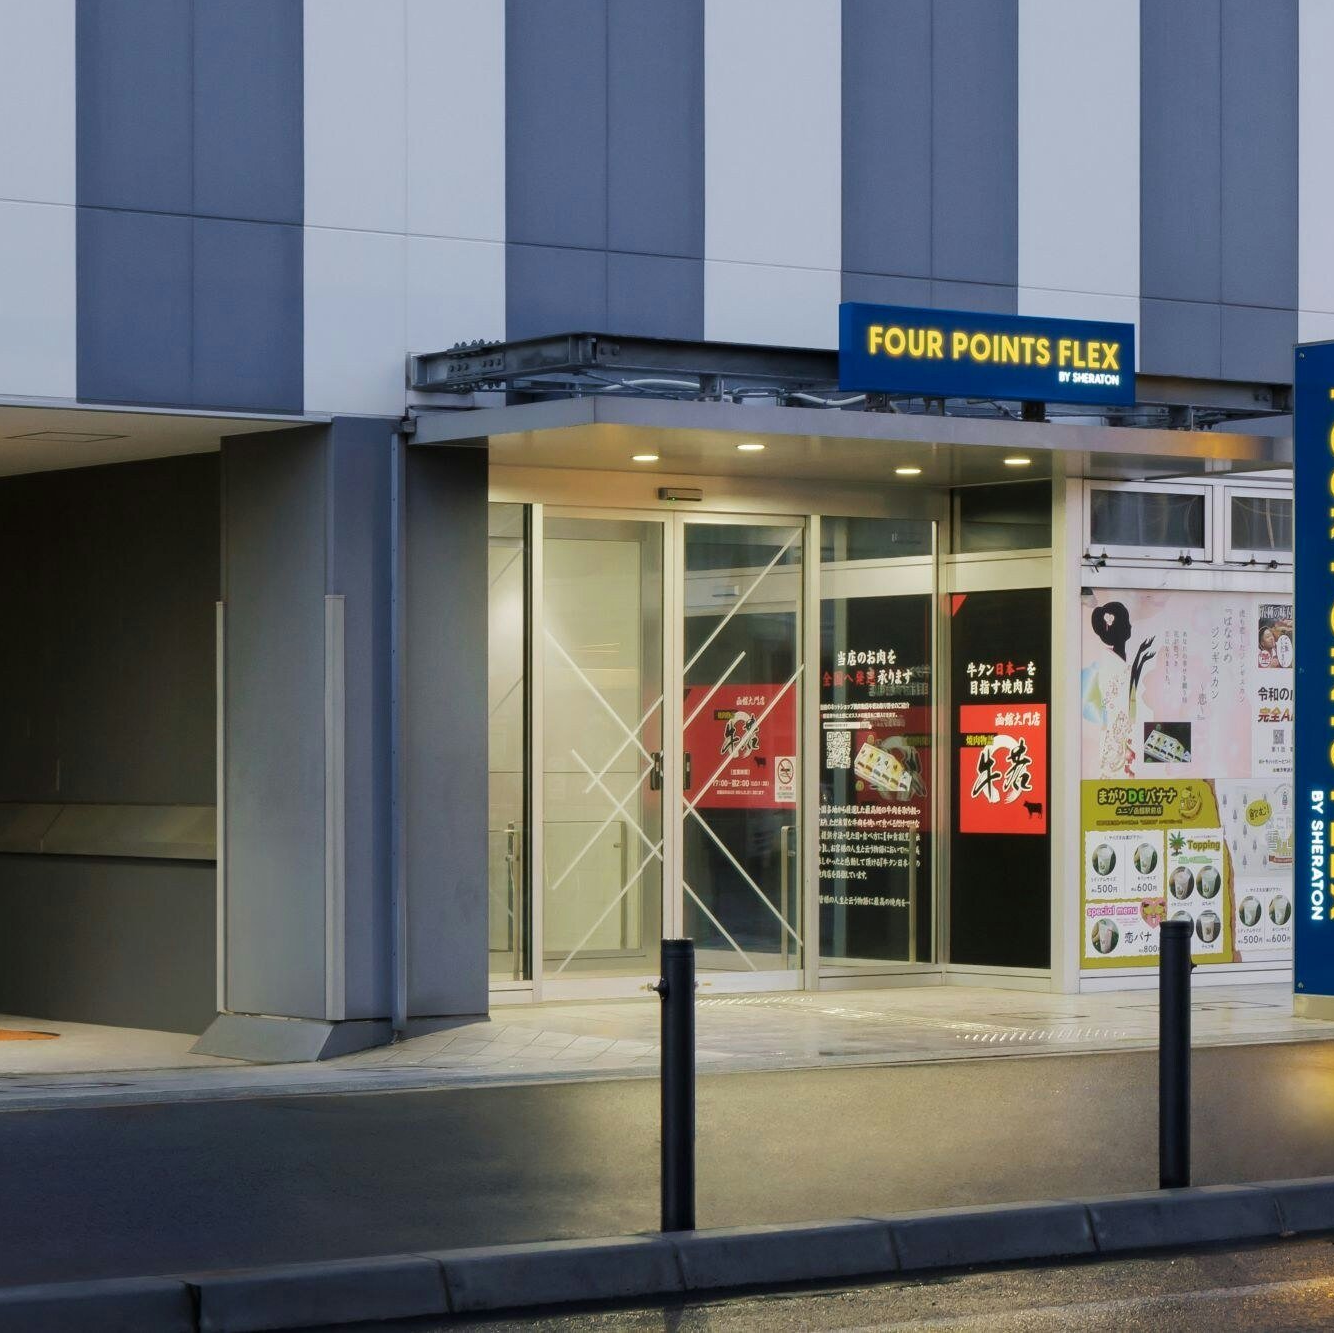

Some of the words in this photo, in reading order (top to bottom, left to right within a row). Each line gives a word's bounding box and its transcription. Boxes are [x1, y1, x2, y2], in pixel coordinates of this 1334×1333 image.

[869, 326, 944, 358] FOUR
[953, 332, 1051, 365] POINTS
[1058, 340, 1119, 369] FLEX
[1059, 371, 1070, 383] BY
[1072, 372, 1120, 386] SHERATON
[837, 649, 897, 667] 当店のお肉を
[1210, 626, 1219, 700] ジンギスカン
[967, 661, 1037, 678] 牛タン日本一を
[969, 678, 1034, 696] 目指す焼肉店
[1257, 687, 1294, 702] 令和の
[995, 711, 1041, 727] 函館大門店
[1257, 707, 1294, 723] 完全A
[1098, 787, 1178, 804] まがりDEバナナ
[1311, 790, 1324, 814] BY
[1187, 839, 1221, 851] Topping
[1311, 820, 1324, 920] SHERATON
[1087, 905, 1116, 918] special
[1117, 906, 1139, 915] menu
[1124, 931, 1153, 944] 恋バナ
